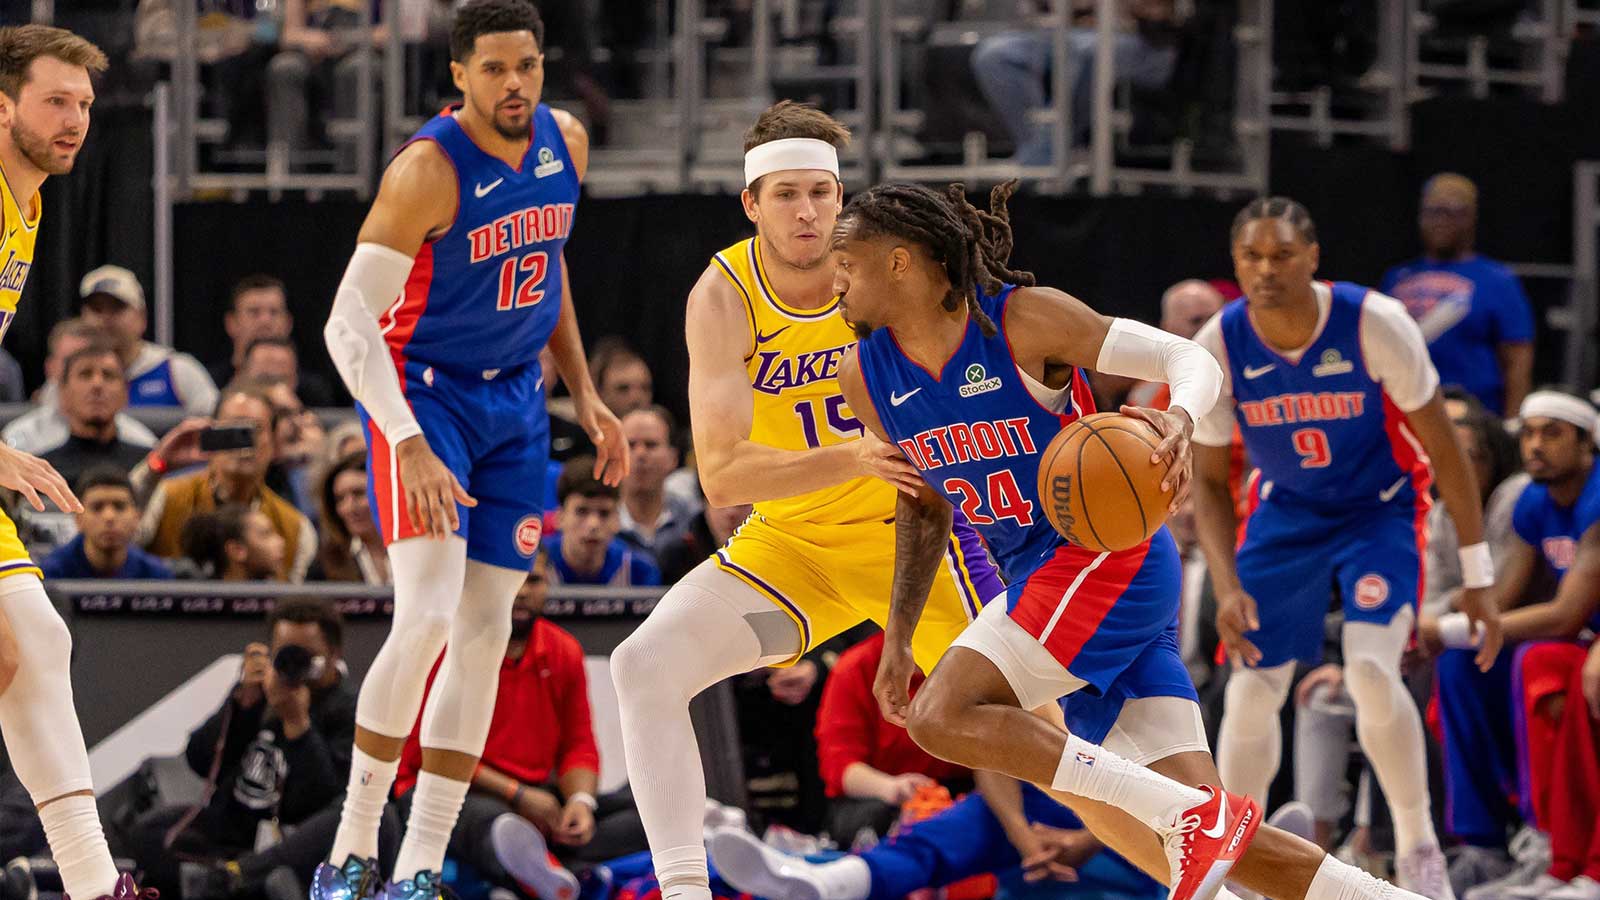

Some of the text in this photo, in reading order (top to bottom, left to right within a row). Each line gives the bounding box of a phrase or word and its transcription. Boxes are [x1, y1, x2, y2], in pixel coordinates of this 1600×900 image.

[468, 204, 574, 264] DETROIT
[496, 251, 549, 311] 12
[752, 342, 857, 396] LAKE
[960, 377, 1001, 397] StockX
[1240, 392, 1365, 426] DETROIT
[897, 417, 1038, 471] DETROIT
[1293, 428, 1332, 468] 9
[944, 469, 1033, 527] 24
